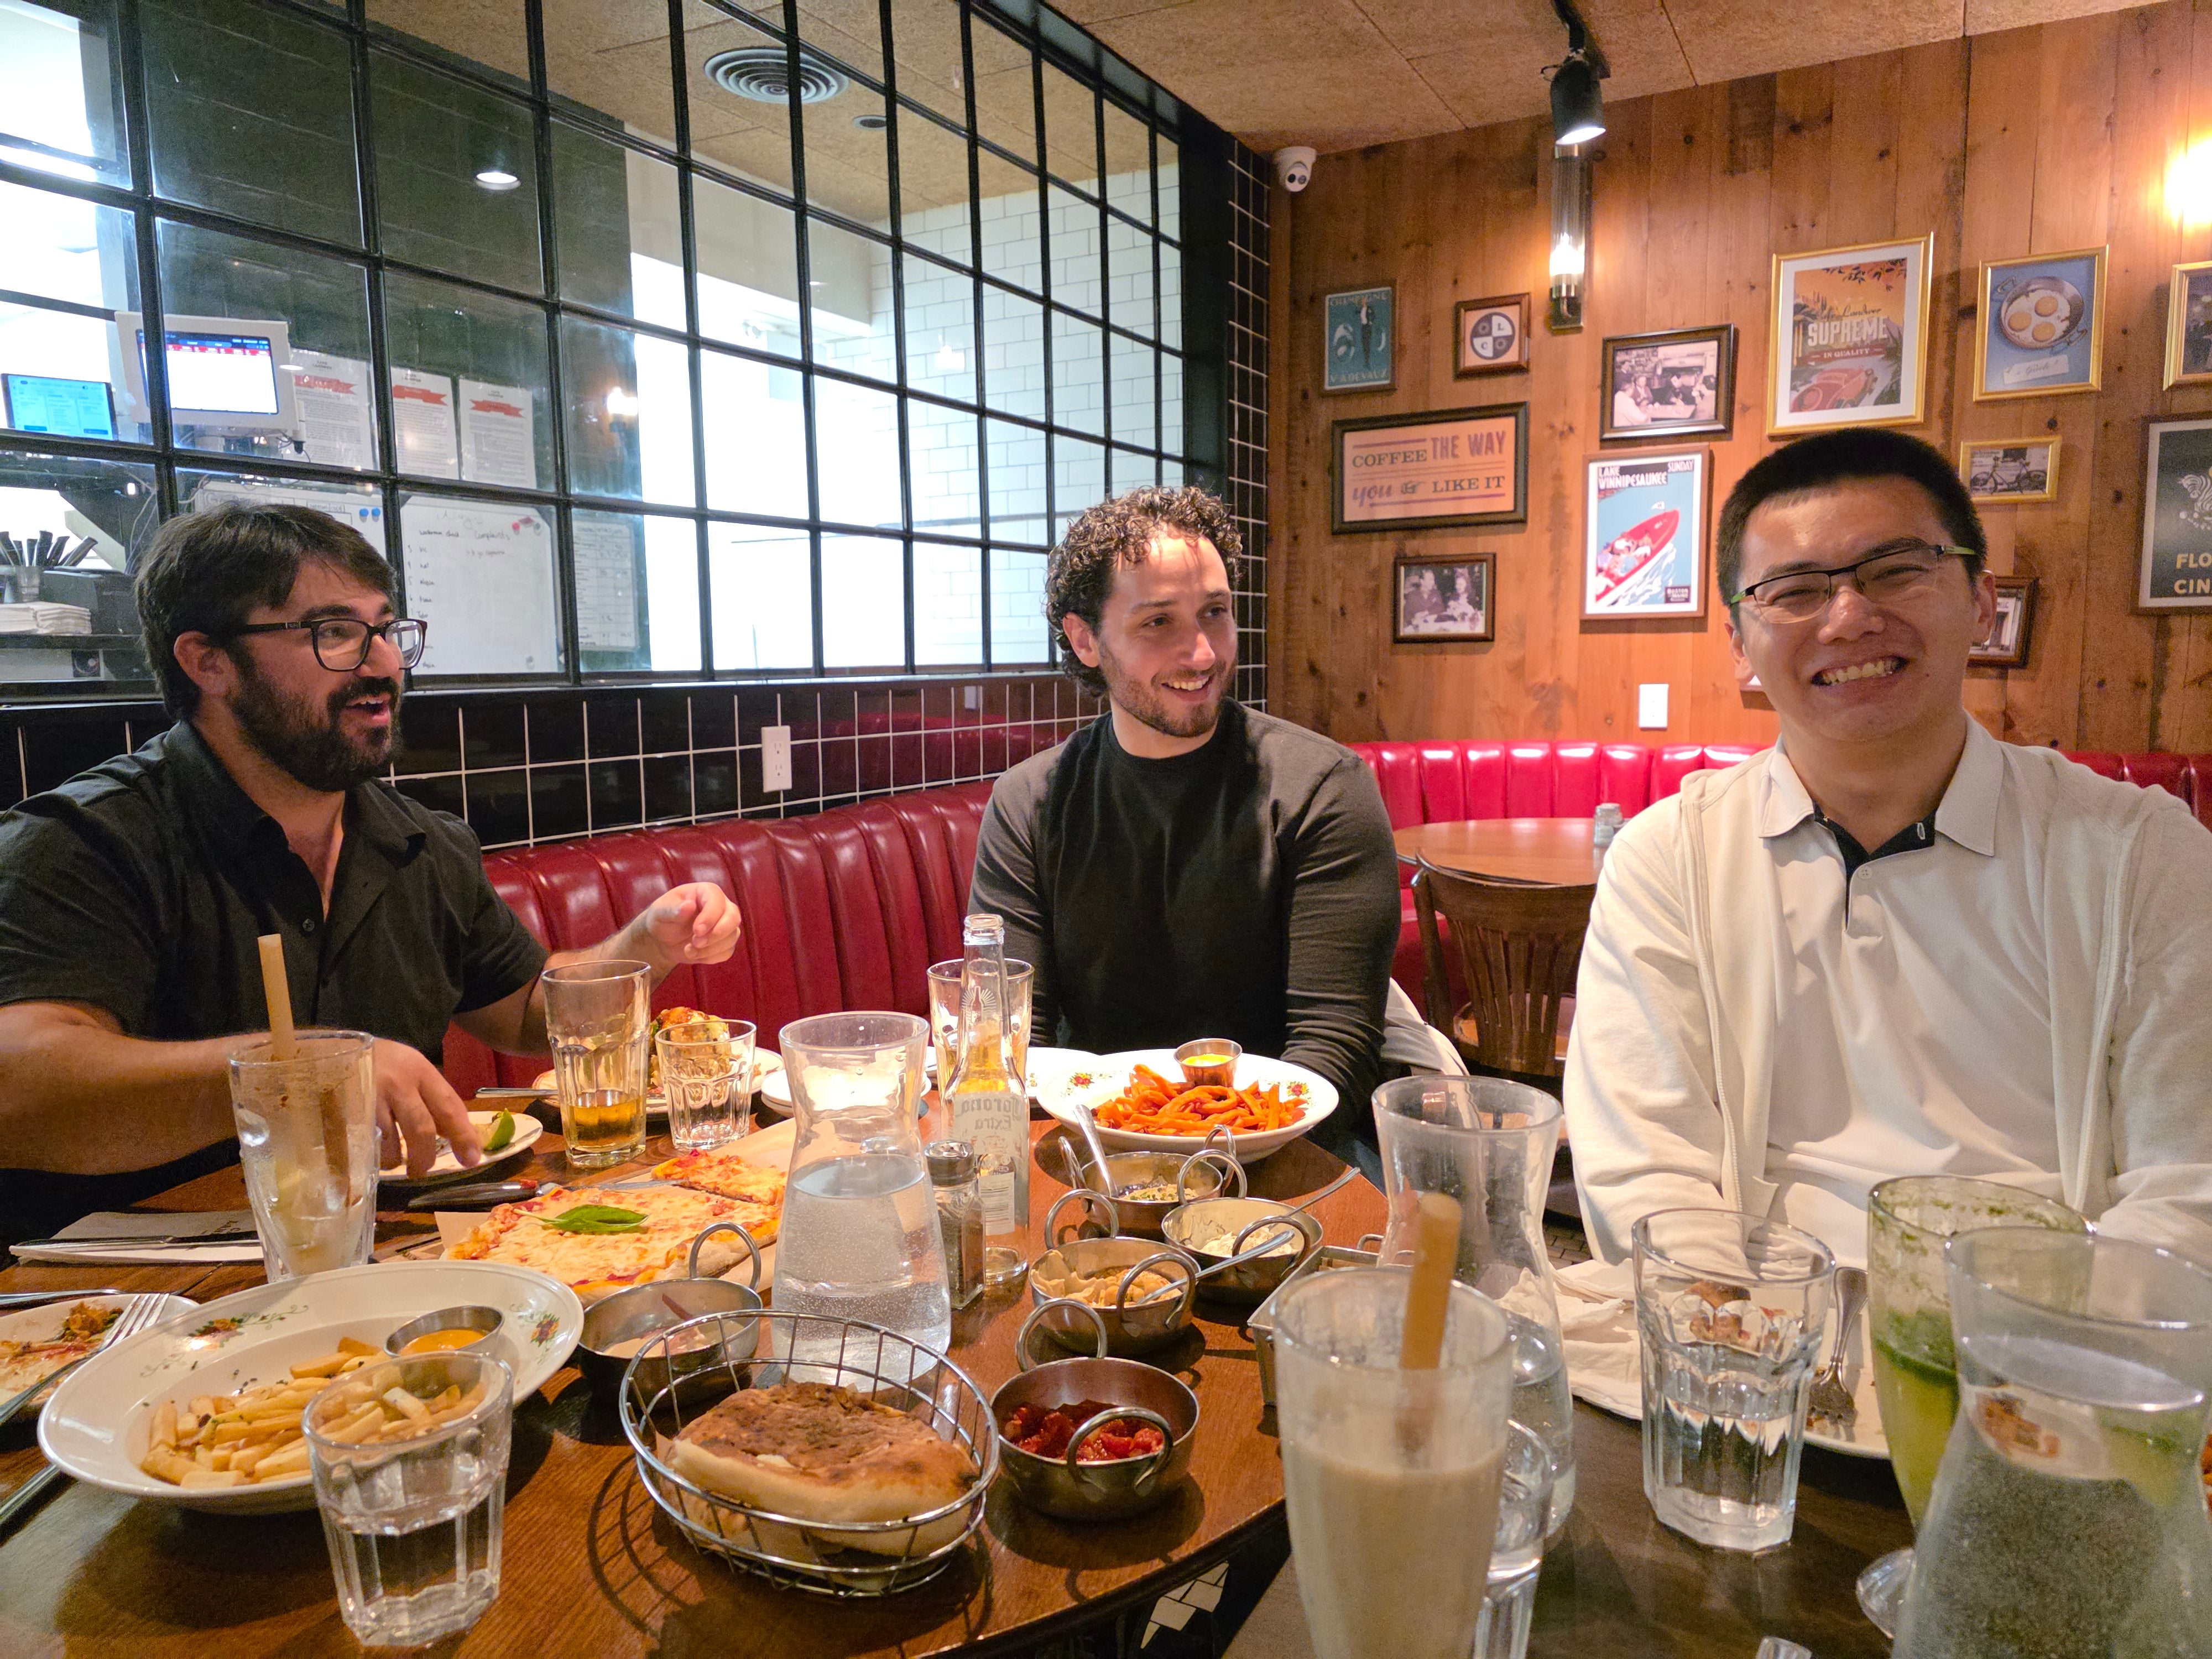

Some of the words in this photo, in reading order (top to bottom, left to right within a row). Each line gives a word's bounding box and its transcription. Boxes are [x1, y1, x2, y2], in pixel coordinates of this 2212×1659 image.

[1808, 317, 1888, 347] SUPREME
[1834, 348, 1870, 358] QUALITY
[1352, 450, 1427, 467] COFFEE
[1431, 435, 1460, 460] THE
[1468, 431, 1506, 456] WAY
[1598, 466, 1621, 477] LAKE
[1598, 472, 1667, 489] WINNIPESAUKEE
[1352, 484, 1392, 507] you
[1432, 478, 1479, 493] LIKE
[1485, 476, 1505, 488] IT
[2176, 552, 2212, 569] FLO
[2174, 578, 2212, 594] CIN
